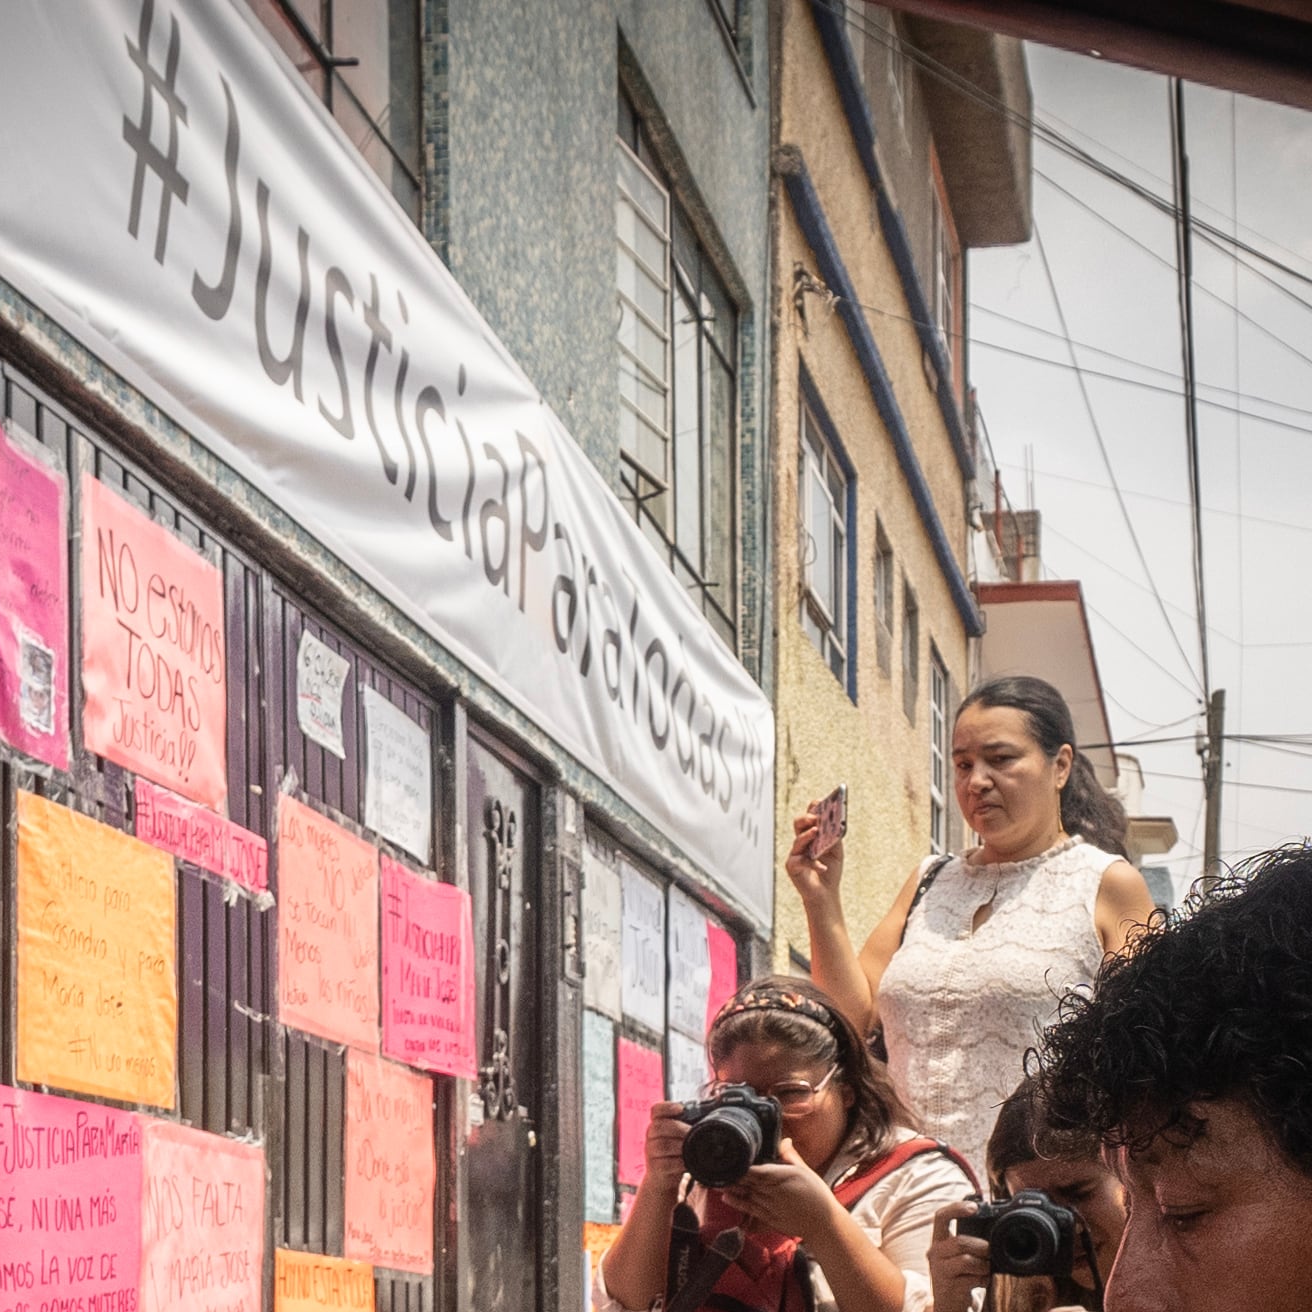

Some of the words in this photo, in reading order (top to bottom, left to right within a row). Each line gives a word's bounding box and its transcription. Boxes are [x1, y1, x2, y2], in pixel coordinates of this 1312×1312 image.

[97, 527, 138, 616] NO
[115, 618, 201, 733] TODAS
[31, 1197, 49, 1232] NI
[89, 1187, 117, 1229] MÁS
[146, 1174, 184, 1241] NOS
[192, 1175, 244, 1228] FALTA
[40, 1248, 60, 1286] LA
[67, 1255, 95, 1286] VOZ
[100, 1252, 118, 1281] DE
